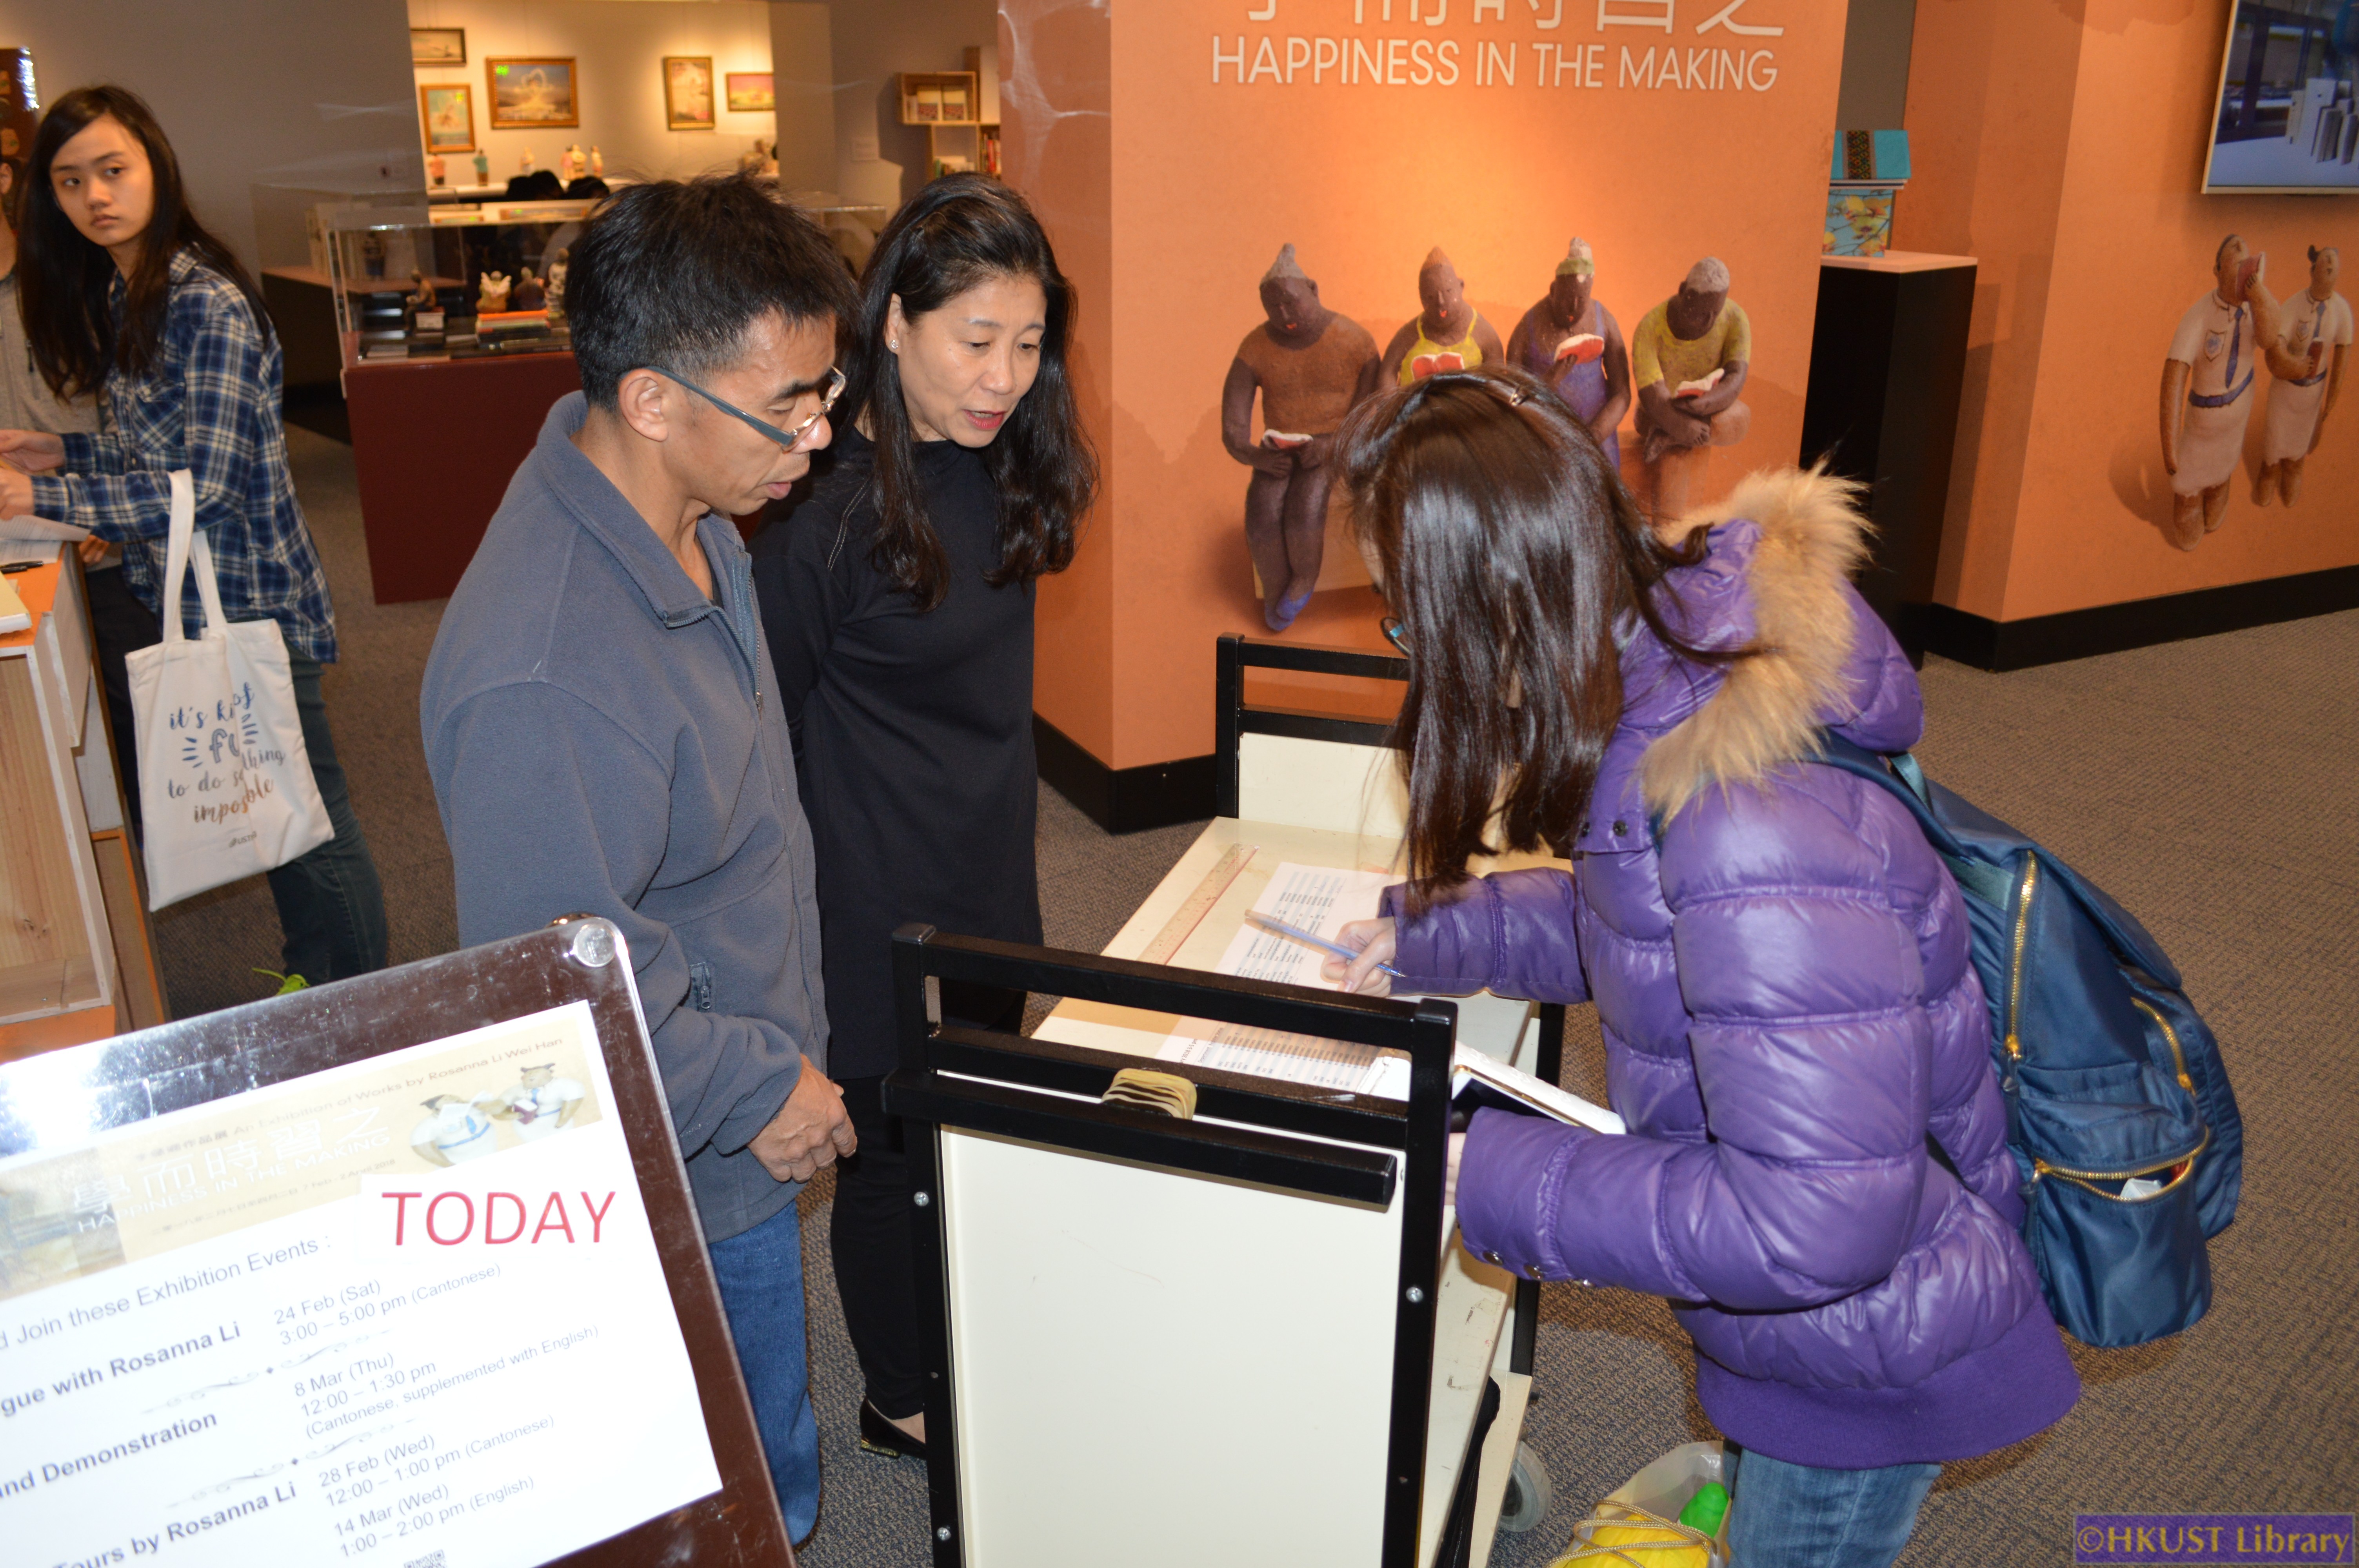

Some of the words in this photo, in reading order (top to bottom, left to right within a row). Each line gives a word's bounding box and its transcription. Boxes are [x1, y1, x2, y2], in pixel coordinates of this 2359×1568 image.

[1212, 36, 1459, 86] HAPPINESS
[1476, 40, 1516, 86] IN
[1532, 42, 1603, 88] THE
[1618, 45, 1778, 92] MAKING
[169, 707, 207, 730] it's
[167, 779, 189, 799] to
[198, 770, 225, 791] do
[234, 1124, 254, 1135] An
[258, 1103, 333, 1129] Exhibition
[336, 1095, 354, 1106] of
[355, 1081, 403, 1101] Works
[406, 1075, 425, 1091] by
[428, 1058, 489, 1081] Rosanna
[492, 1051, 503, 1064] Li
[505, 1045, 533, 1059] Wei
[536, 1037, 563, 1052] Han
[74, 1107, 388, 1214] 學而時習之
[78, 1183, 208, 1233] HAPPINESS
[215, 1176, 238, 1194] IN
[246, 1163, 287, 1184] THE
[294, 1132, 390, 1170] MAKING
[312, 1178, 332, 1189] Feb
[374, 1158, 396, 1170] 2018
[381, 1191, 616, 1246] TODAY
[17, 1318, 63, 1343] Join
[68, 1294, 131, 1330] these
[136, 1261, 241, 1307] Exhibition
[247, 1240, 319, 1272] Events
[273, 1306, 297, 1325] 24
[302, 1296, 335, 1317] Feb
[340, 1279, 382, 1306] (Sat)
[280, 1321, 318, 1346] 3:00
[339, 1305, 376, 1327] 5:00
[380, 1295, 407, 1315] pm
[411, 1263, 501, 1305] (Cantonese)
[0, 1388, 46, 1417] gue
[52, 1365, 104, 1396] with
[109, 1333, 213, 1378] Rosanna
[218, 1321, 241, 1343] Li
[294, 1381, 305, 1397] 8
[310, 1368, 343, 1392] Mar
[349, 1352, 394, 1381] (Thu)
[301, 1388, 349, 1417] 12:00
[369, 1371, 406, 1394] 1:30
[410, 1359, 437, 1383] pm
[306, 1396, 399, 1440] (Cantonese,
[402, 1356, 506, 1403] supplemented
[509, 1344, 538, 1365] with
[540, 1325, 599, 1354] English)
[0, 1469, 36, 1499] nd
[42, 1411, 218, 1483] Demonstration
[319, 1470, 342, 1488] 28
[346, 1455, 380, 1479] Feb
[384, 1434, 436, 1466] (Wed)
[325, 1478, 374, 1507] 12:00
[394, 1458, 430, 1482] 1:00
[434, 1448, 462, 1471] pm
[465, 1414, 555, 1459] (Cantonese)
[131, 1533, 160, 1555] by
[167, 1496, 270, 1543] Rosanna
[274, 1480, 297, 1503] Li
[334, 1519, 356, 1537] 14
[359, 1504, 393, 1528] Mar
[398, 1484, 449, 1517] (Wed)
[340, 1532, 378, 1557] 1:00
[396, 1512, 434, 1537] 2:00
[439, 1503, 465, 1526] pm
[469, 1475, 535, 1513] (English)
